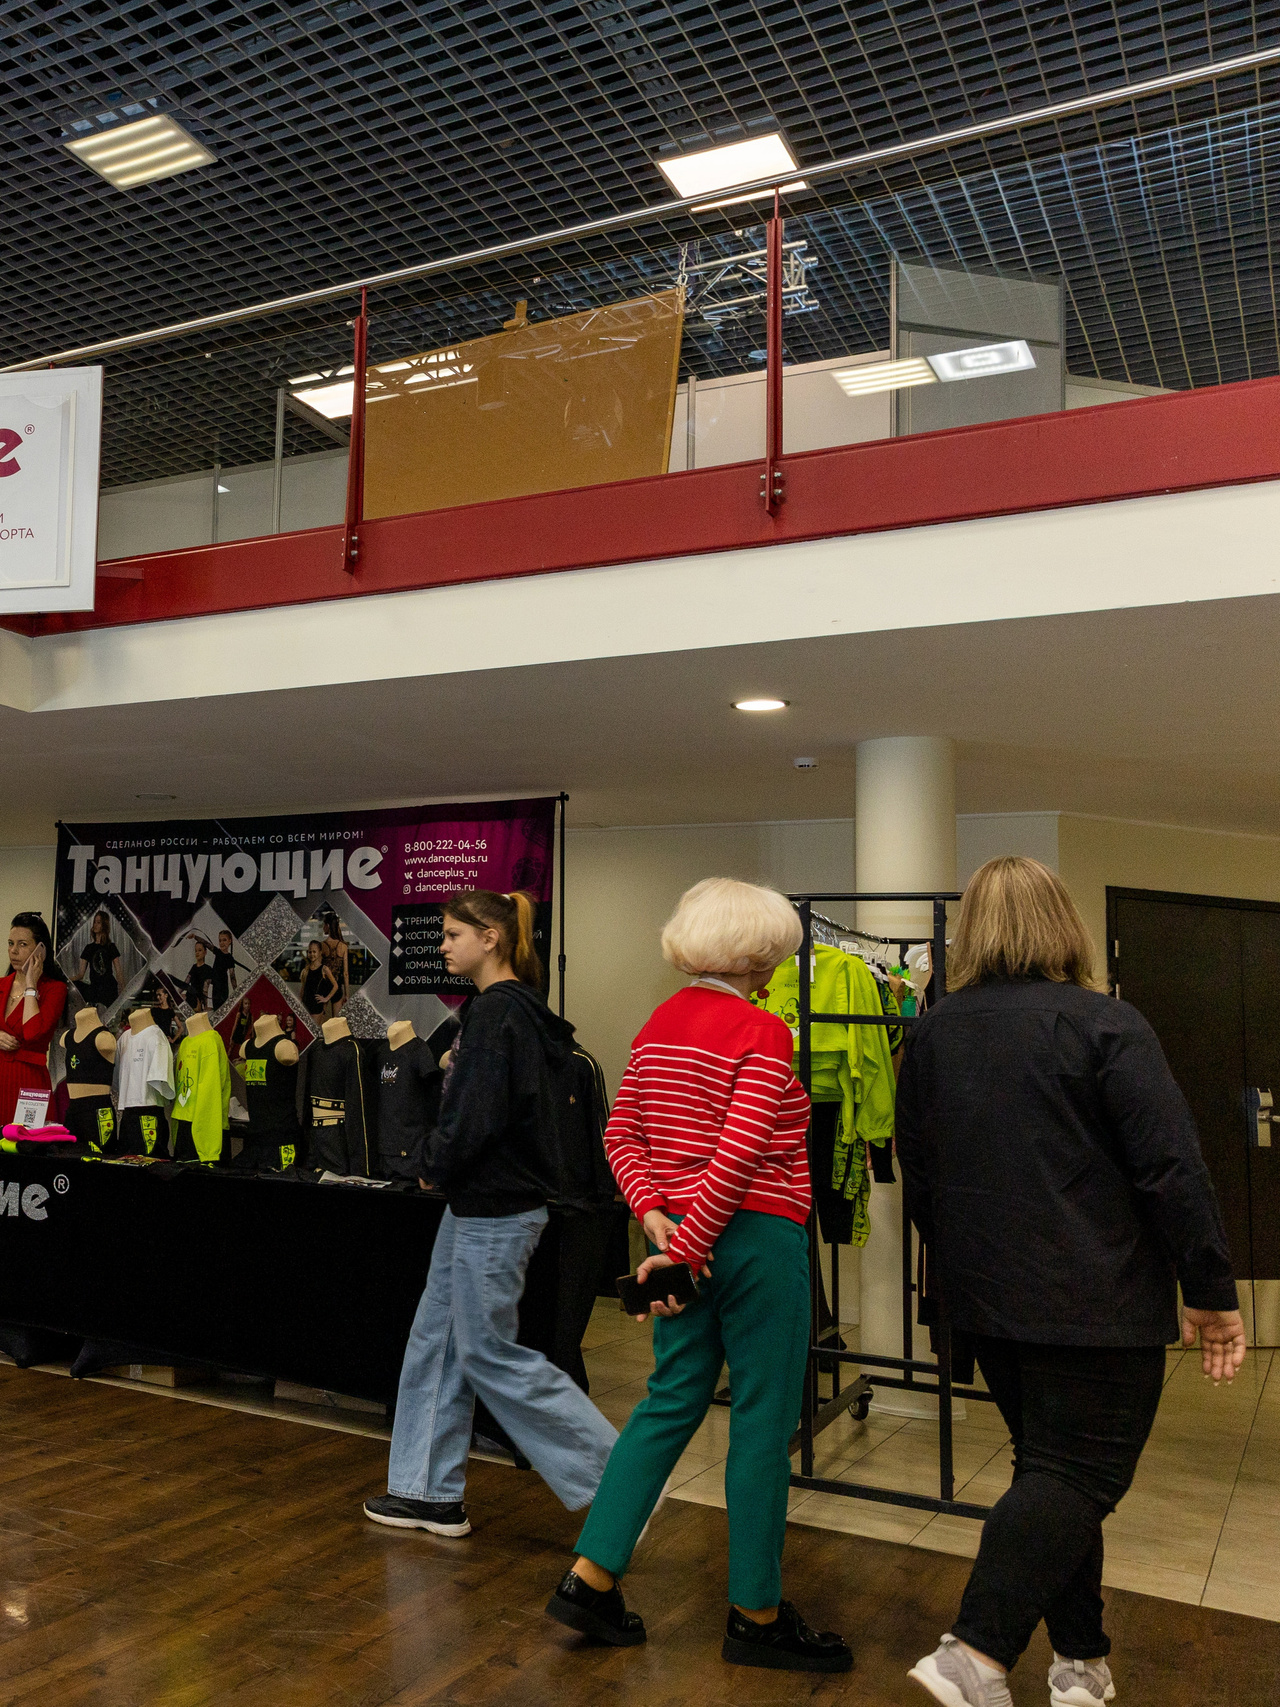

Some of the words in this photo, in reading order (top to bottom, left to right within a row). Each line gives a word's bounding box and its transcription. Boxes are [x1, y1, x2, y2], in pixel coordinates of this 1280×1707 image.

[212, 836, 265, 846] РАБОТАЕМ
[269, 835, 283, 843] СО
[288, 833, 315, 843] ВСЕМ
[320, 831, 364, 841] МИРОМ!
[404, 839, 487, 853] 8-800-222-04-56
[404, 853, 488, 866] www.danceplus.ru
[416, 867, 478, 880] danceplus_ru
[415, 881, 475, 893] danceplus.ru
[405, 945, 443, 955] СПОРТИ
[405, 961, 443, 970] КОМАНД
[404, 976, 432, 984] ОБУВЬ
[433, 976, 440, 984] И
